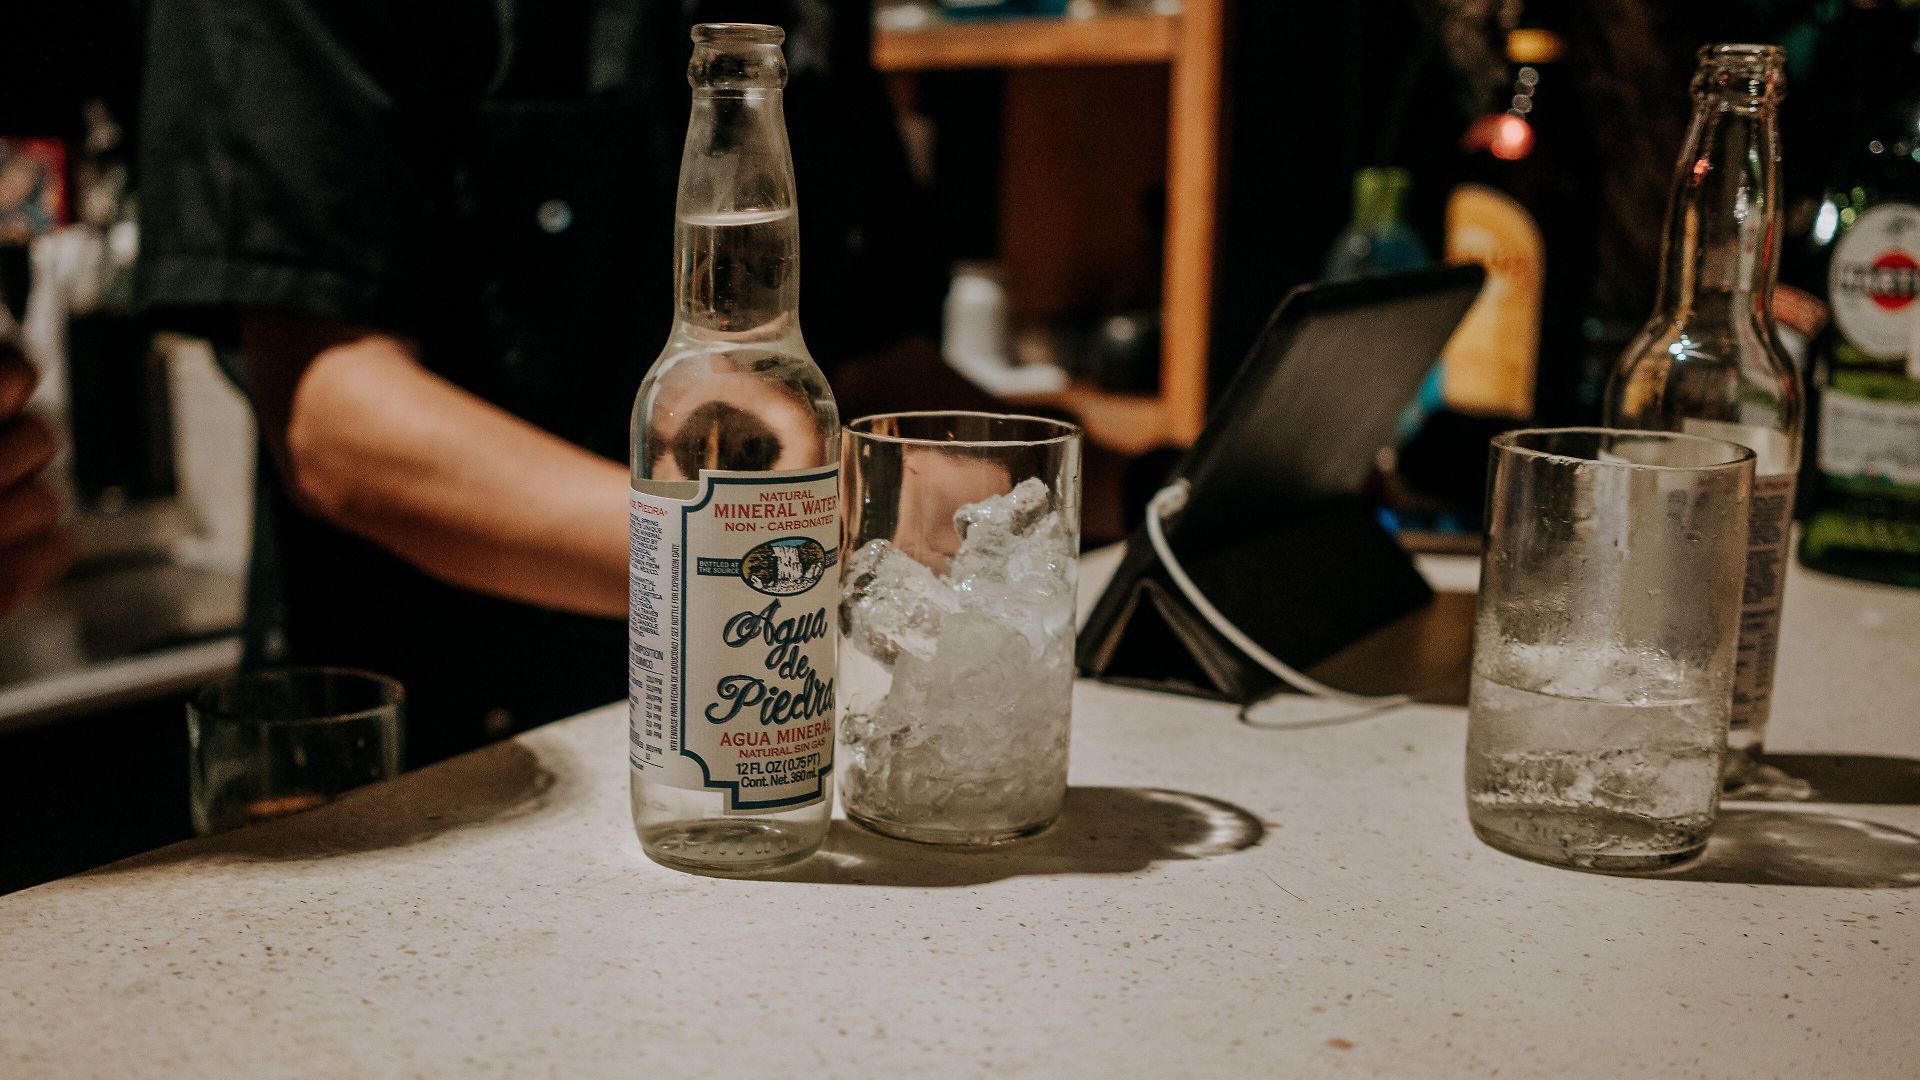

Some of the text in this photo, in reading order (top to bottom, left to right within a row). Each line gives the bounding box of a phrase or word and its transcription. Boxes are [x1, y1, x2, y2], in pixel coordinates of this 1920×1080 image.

[760, 489, 814, 502] NATURAL
[714, 495, 837, 519] MINERAL WATER
[725, 522, 756, 532] NON
[767, 514, 834, 532] CARBONATED
[671, 543, 679, 558] DATE
[671, 558, 679, 591] EXPIRATION
[699, 560, 730, 569] BOTTLED
[671, 604, 679, 625] BOTTLE
[722, 598, 828, 670] Agua
[778, 644, 810, 681] de
[704, 668, 834, 726] Piedra
[670, 702, 678, 717] PARA
[719, 719, 832, 747] AGUA MINERAL
[739, 737, 826, 759] NATURAL SIN GAS
[736, 762, 749, 775] 12
[750, 762, 763, 775] FL
[765, 760, 782, 774] OZ
[740, 776, 769, 788] Cont.
[770, 775, 790, 787] Net.
[790, 769, 806, 784] 360
